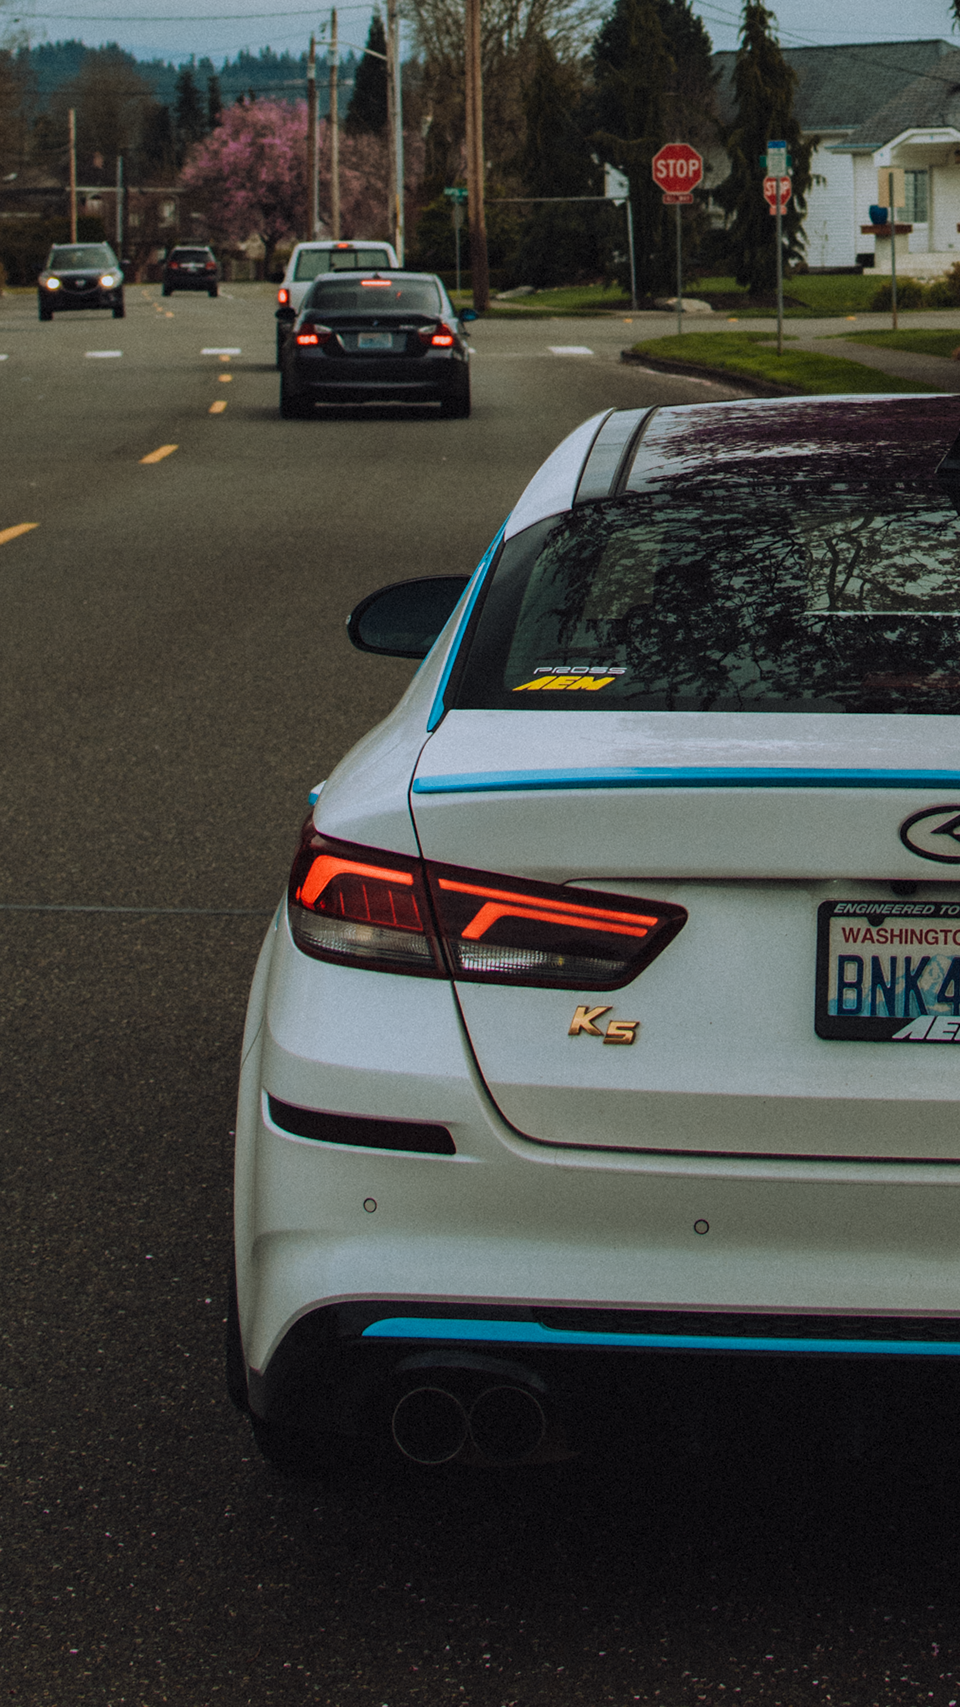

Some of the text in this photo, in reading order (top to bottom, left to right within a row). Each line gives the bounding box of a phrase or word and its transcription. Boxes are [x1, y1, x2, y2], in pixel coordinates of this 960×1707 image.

[656, 159, 699, 179] STOP
[533, 666, 628, 675] PROSS
[512, 675, 616, 692] AEM
[833, 903, 935, 916] ENGINEERED
[939, 904, 960, 916] TO
[567, 1004, 641, 1045] K5
